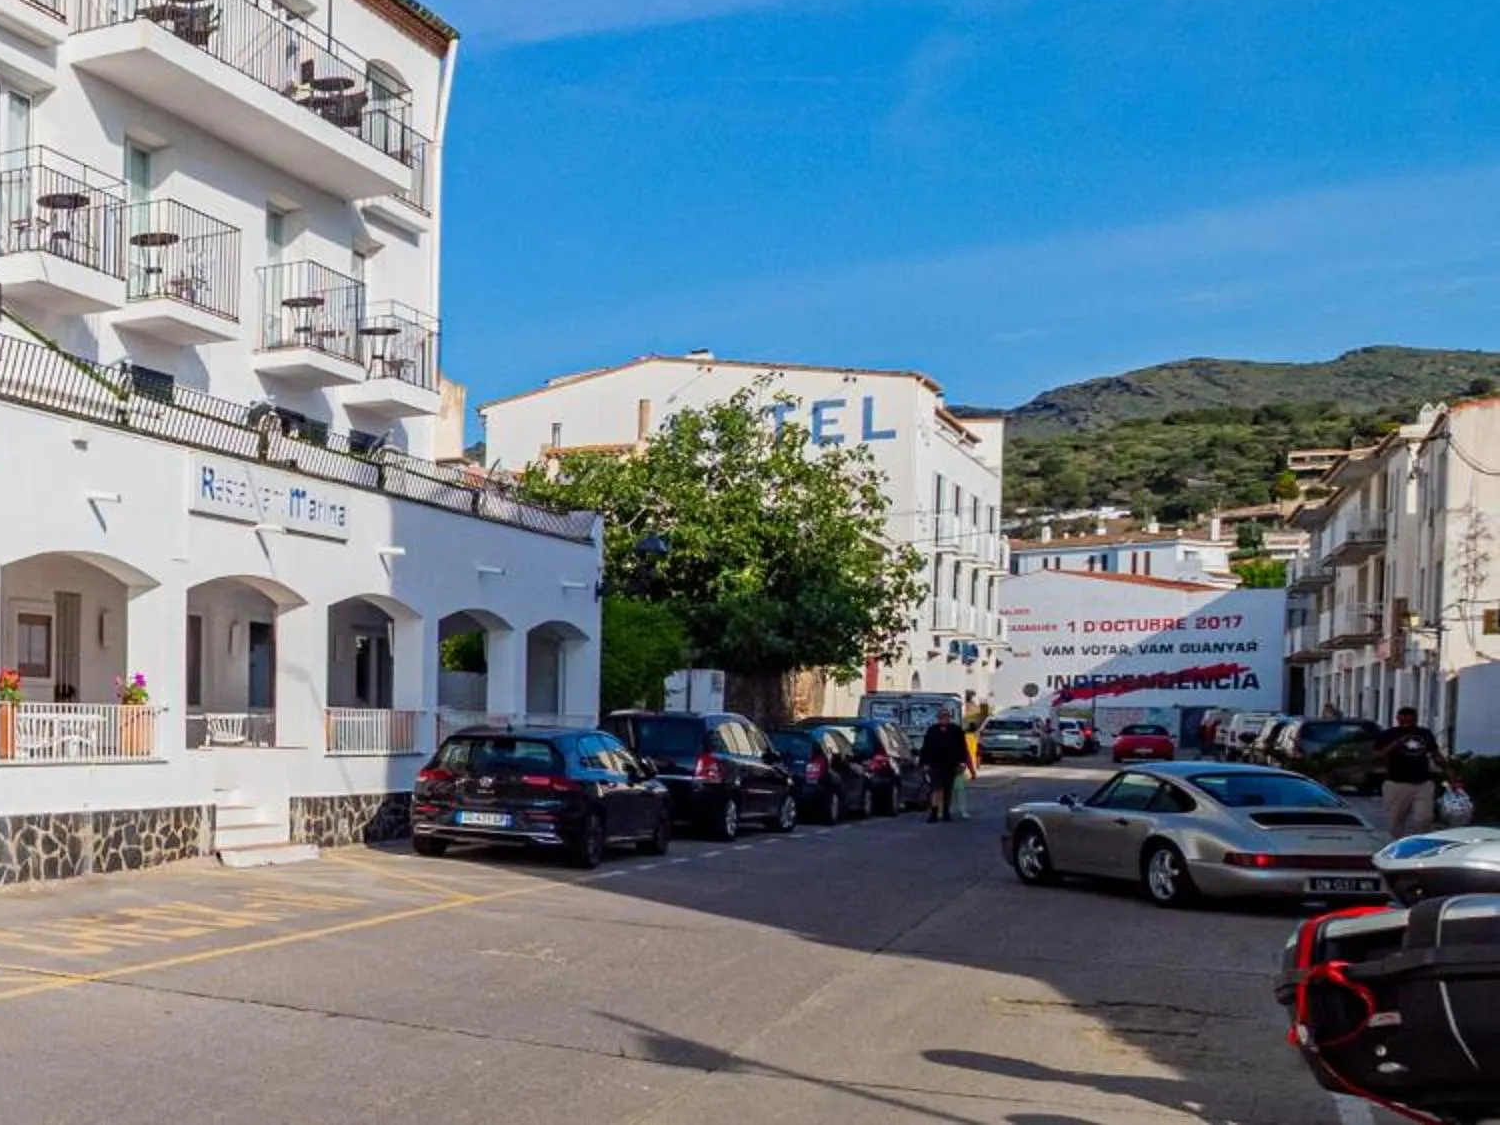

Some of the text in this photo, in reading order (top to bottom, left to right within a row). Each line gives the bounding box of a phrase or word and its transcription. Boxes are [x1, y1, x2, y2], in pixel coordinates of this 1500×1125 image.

[764, 396, 897, 446] TEL
[1194, 615, 1243, 630] 2017
[1043, 644, 1075, 656] VAM
[1138, 642, 1175, 655] VAM
